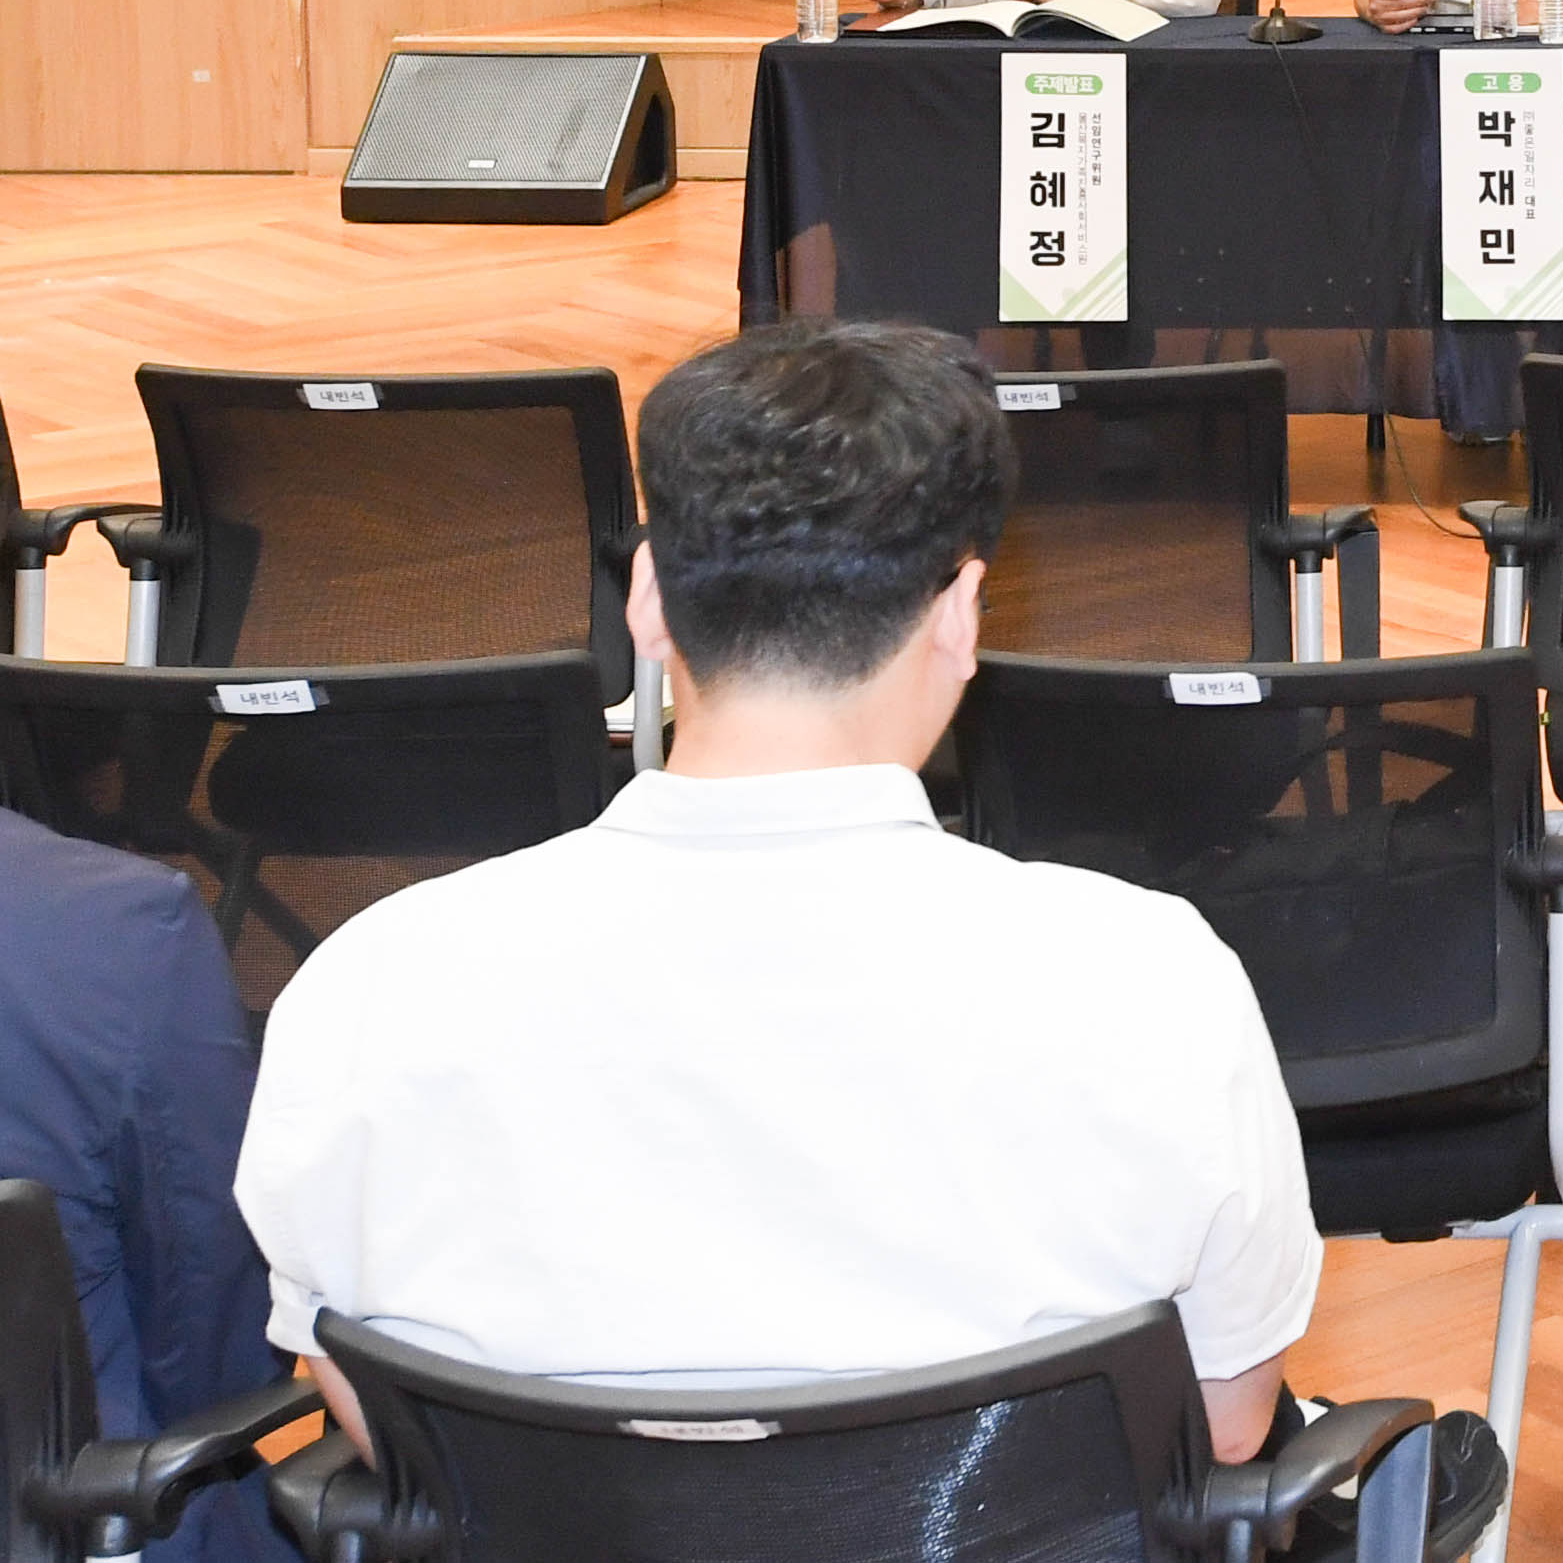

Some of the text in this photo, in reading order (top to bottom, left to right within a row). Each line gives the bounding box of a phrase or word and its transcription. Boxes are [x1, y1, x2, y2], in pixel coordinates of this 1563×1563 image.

[1033, 75, 1094, 94] 주제발표
[1029, 111, 1067, 267] 김혜정
[1477, 110, 1516, 265] 박재민
[320, 389, 366, 403] 내빈석
[1004, 390, 1050, 403] 내빈석
[1189, 680, 1245, 695] 내빈석
[240, 689, 300, 705] 내빈석
